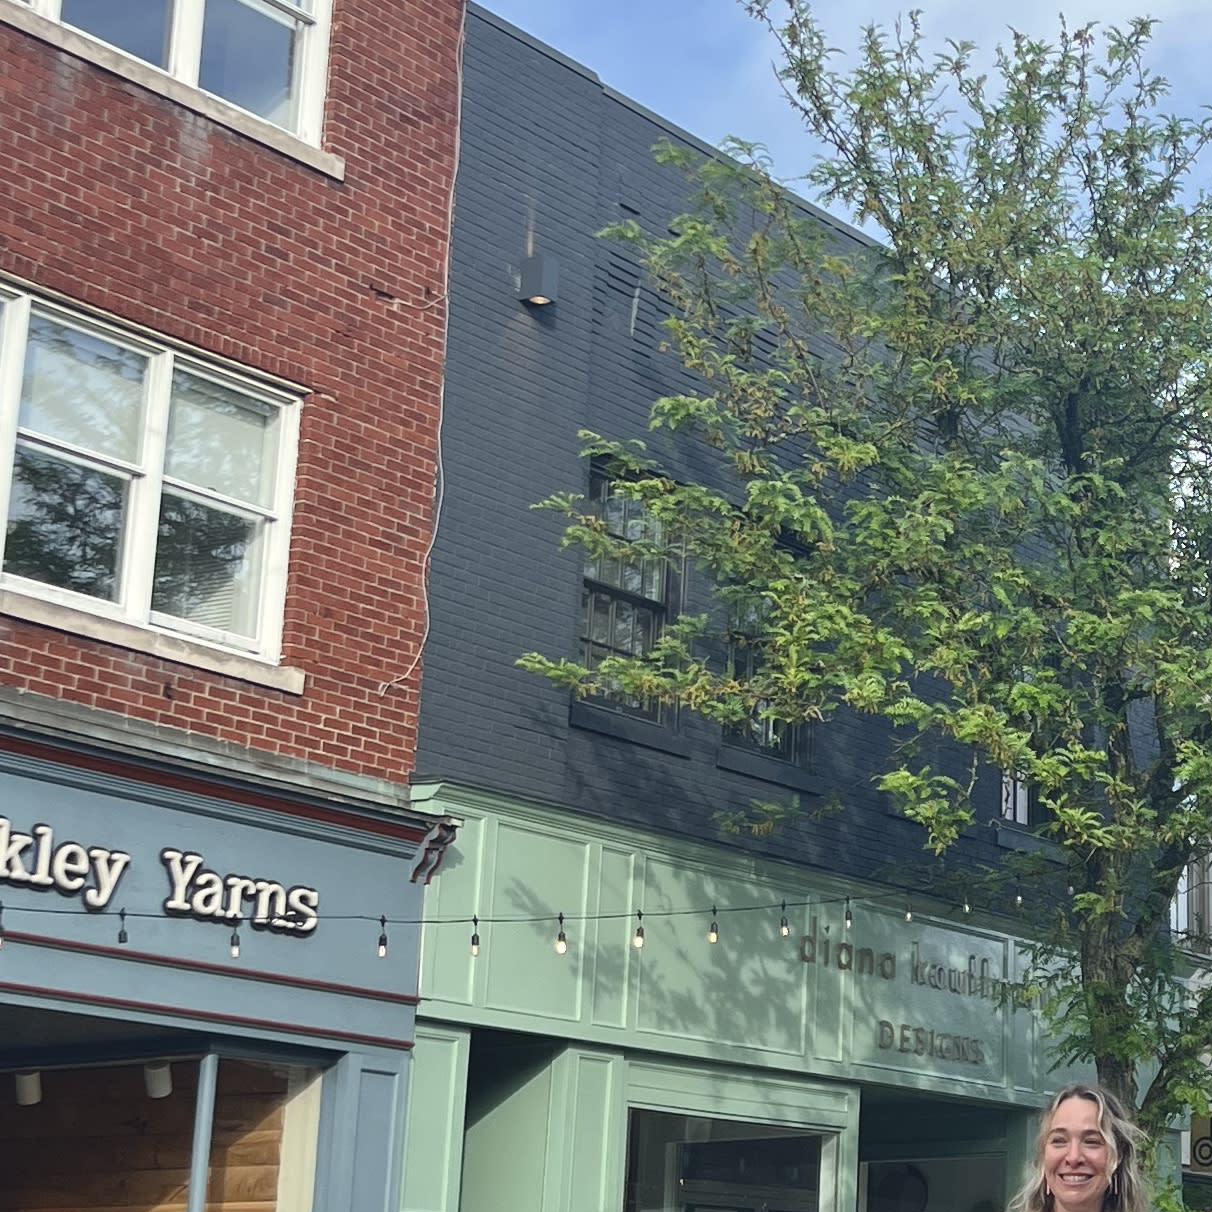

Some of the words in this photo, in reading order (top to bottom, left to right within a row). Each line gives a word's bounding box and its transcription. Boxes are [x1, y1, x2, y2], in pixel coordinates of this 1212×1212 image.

[162, 850, 319, 934] Yarns
[800, 916, 897, 981] diana
[910, 941, 1000, 1001] kauff
[877, 1019, 985, 1065] DESIGNS
